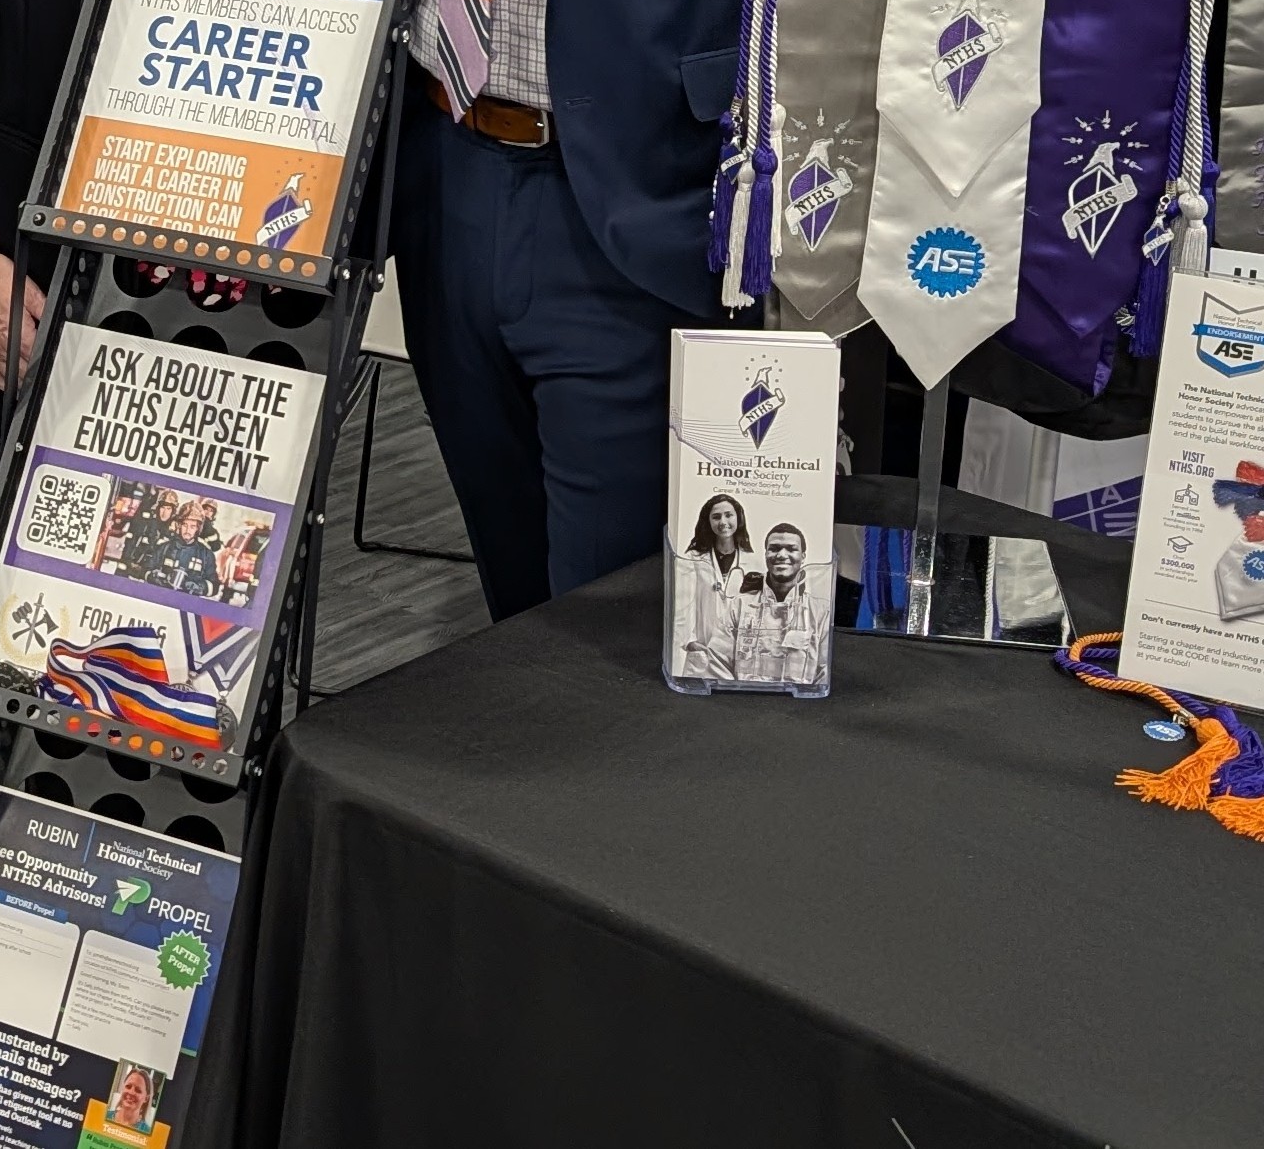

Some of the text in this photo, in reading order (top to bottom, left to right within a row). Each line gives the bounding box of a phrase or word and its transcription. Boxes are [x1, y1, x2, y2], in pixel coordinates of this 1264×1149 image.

[261, 3, 296, 28] CAN
[296, 8, 359, 35] ACCESS
[147, 16, 311, 70] CAREER
[941, 37, 987, 72] NTHS
[138, 52, 324, 111] STARTER
[107, 88, 338, 145] THROUGH THE MEMBER PORTAL
[103, 135, 248, 179] START EXPLORING
[94, 157, 244, 204] WHAT A CAREER IN
[83, 181, 204, 222] CONSTRUCTION
[206, 202, 243, 229] CAN
[797, 184, 835, 215] NTHS
[1075, 189, 1119, 221] NTHS
[264, 212, 299, 236] NTHS
[914, 246, 976, 275] ASE
[1213, 341, 1254, 361] ASE
[88, 344, 293, 418] ASK ABOUT THE
[1183, 383, 1199, 393] The
[1200, 386, 1234, 399] National
[91, 381, 270, 451] NTHS LAPSEN
[745, 401, 775, 424] NTHS
[1178, 392, 1235, 410] Honor Society
[74, 415, 270, 491] ENDORSEMENT
[713, 454, 821, 472] National Technical
[1182, 450, 1206, 464] VISIT
[696, 461, 790, 483] Honor Society
[1169, 460, 1215, 478] NTHS.ORG
[713, 486, 734, 494] Career
[741, 487, 770, 496] Technical
[771, 489, 803, 498] Education
[725, 479, 737, 487] The
[738, 480, 757, 488] Honor
[758, 481, 781, 491] Society
[79, 605, 113, 633] FOR
[1141, 614, 1260, 645] Don't currently have an NTHS
[26, 819, 79, 849] RUBIN
[16, 847, 98, 889] Opportunity
[97, 842, 173, 881] Honor Society
[112, 840, 201, 876] National Technical
[1, 864, 41, 888] NTHS
[42, 877, 107, 909] Advisors!
[147, 897, 213, 933] PROPEL
[167, 955, 196, 977] Propel
[172, 944, 201, 965] AFTER
[27, 1057, 54, 1077] that
[52, 1044, 70, 1066] by
[11, 1068, 82, 1102] messages?
[103, 1124, 148, 1146] Testimonial
